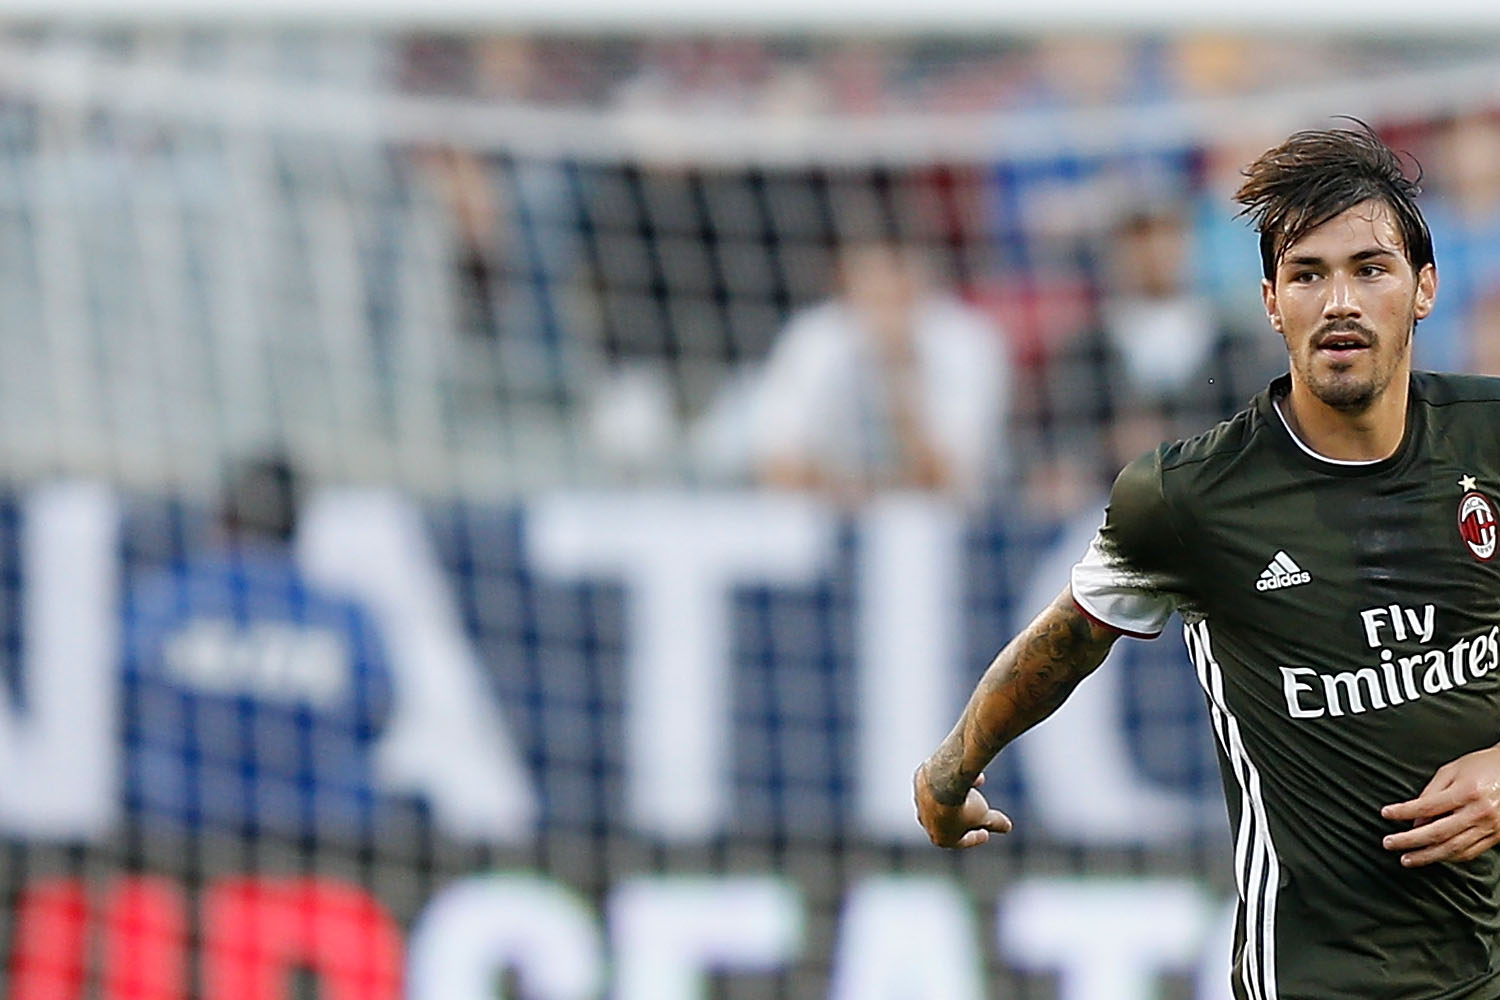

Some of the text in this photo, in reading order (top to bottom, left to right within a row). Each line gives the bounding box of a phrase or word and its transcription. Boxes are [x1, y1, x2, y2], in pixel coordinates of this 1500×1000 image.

[1256, 570, 1311, 592] adidas
[1360, 603, 1435, 648] Fly
[1279, 625, 1500, 719] Emirates
